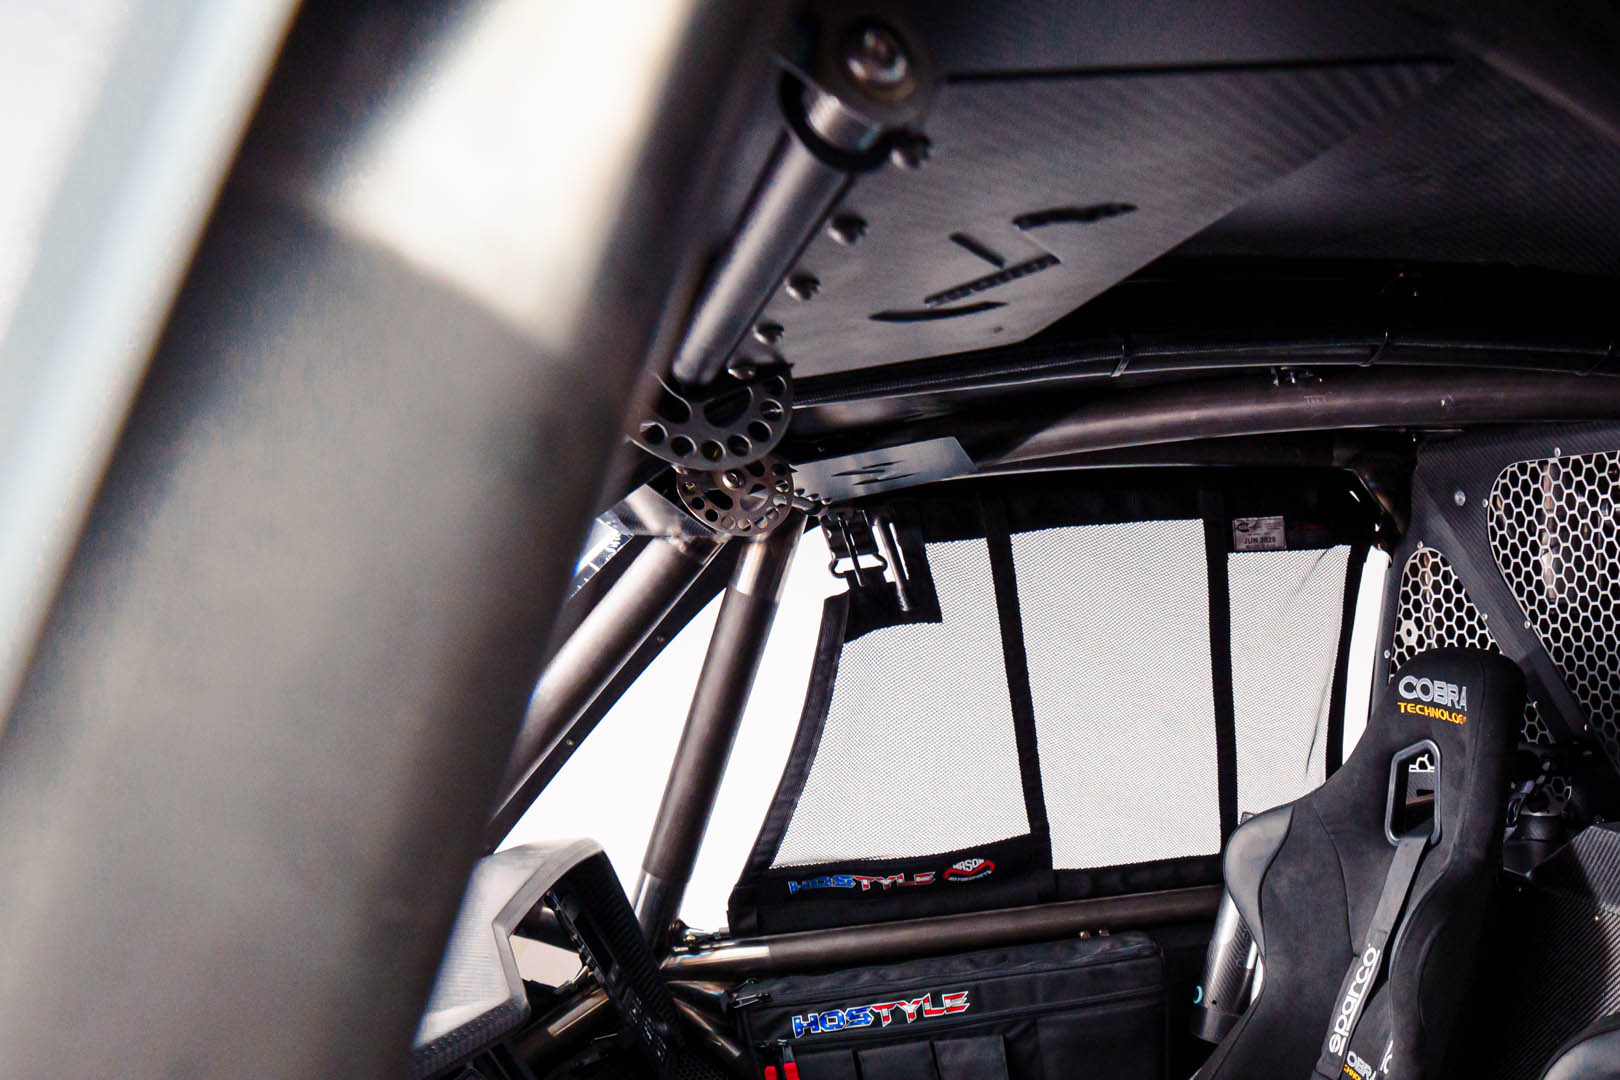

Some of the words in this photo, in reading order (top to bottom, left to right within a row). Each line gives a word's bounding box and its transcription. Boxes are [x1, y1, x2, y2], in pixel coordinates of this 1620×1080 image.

[1398, 675, 1467, 712] COBRA
[792, 991, 970, 1038] HOSTYLE
[1328, 946, 1381, 1057] sparco
